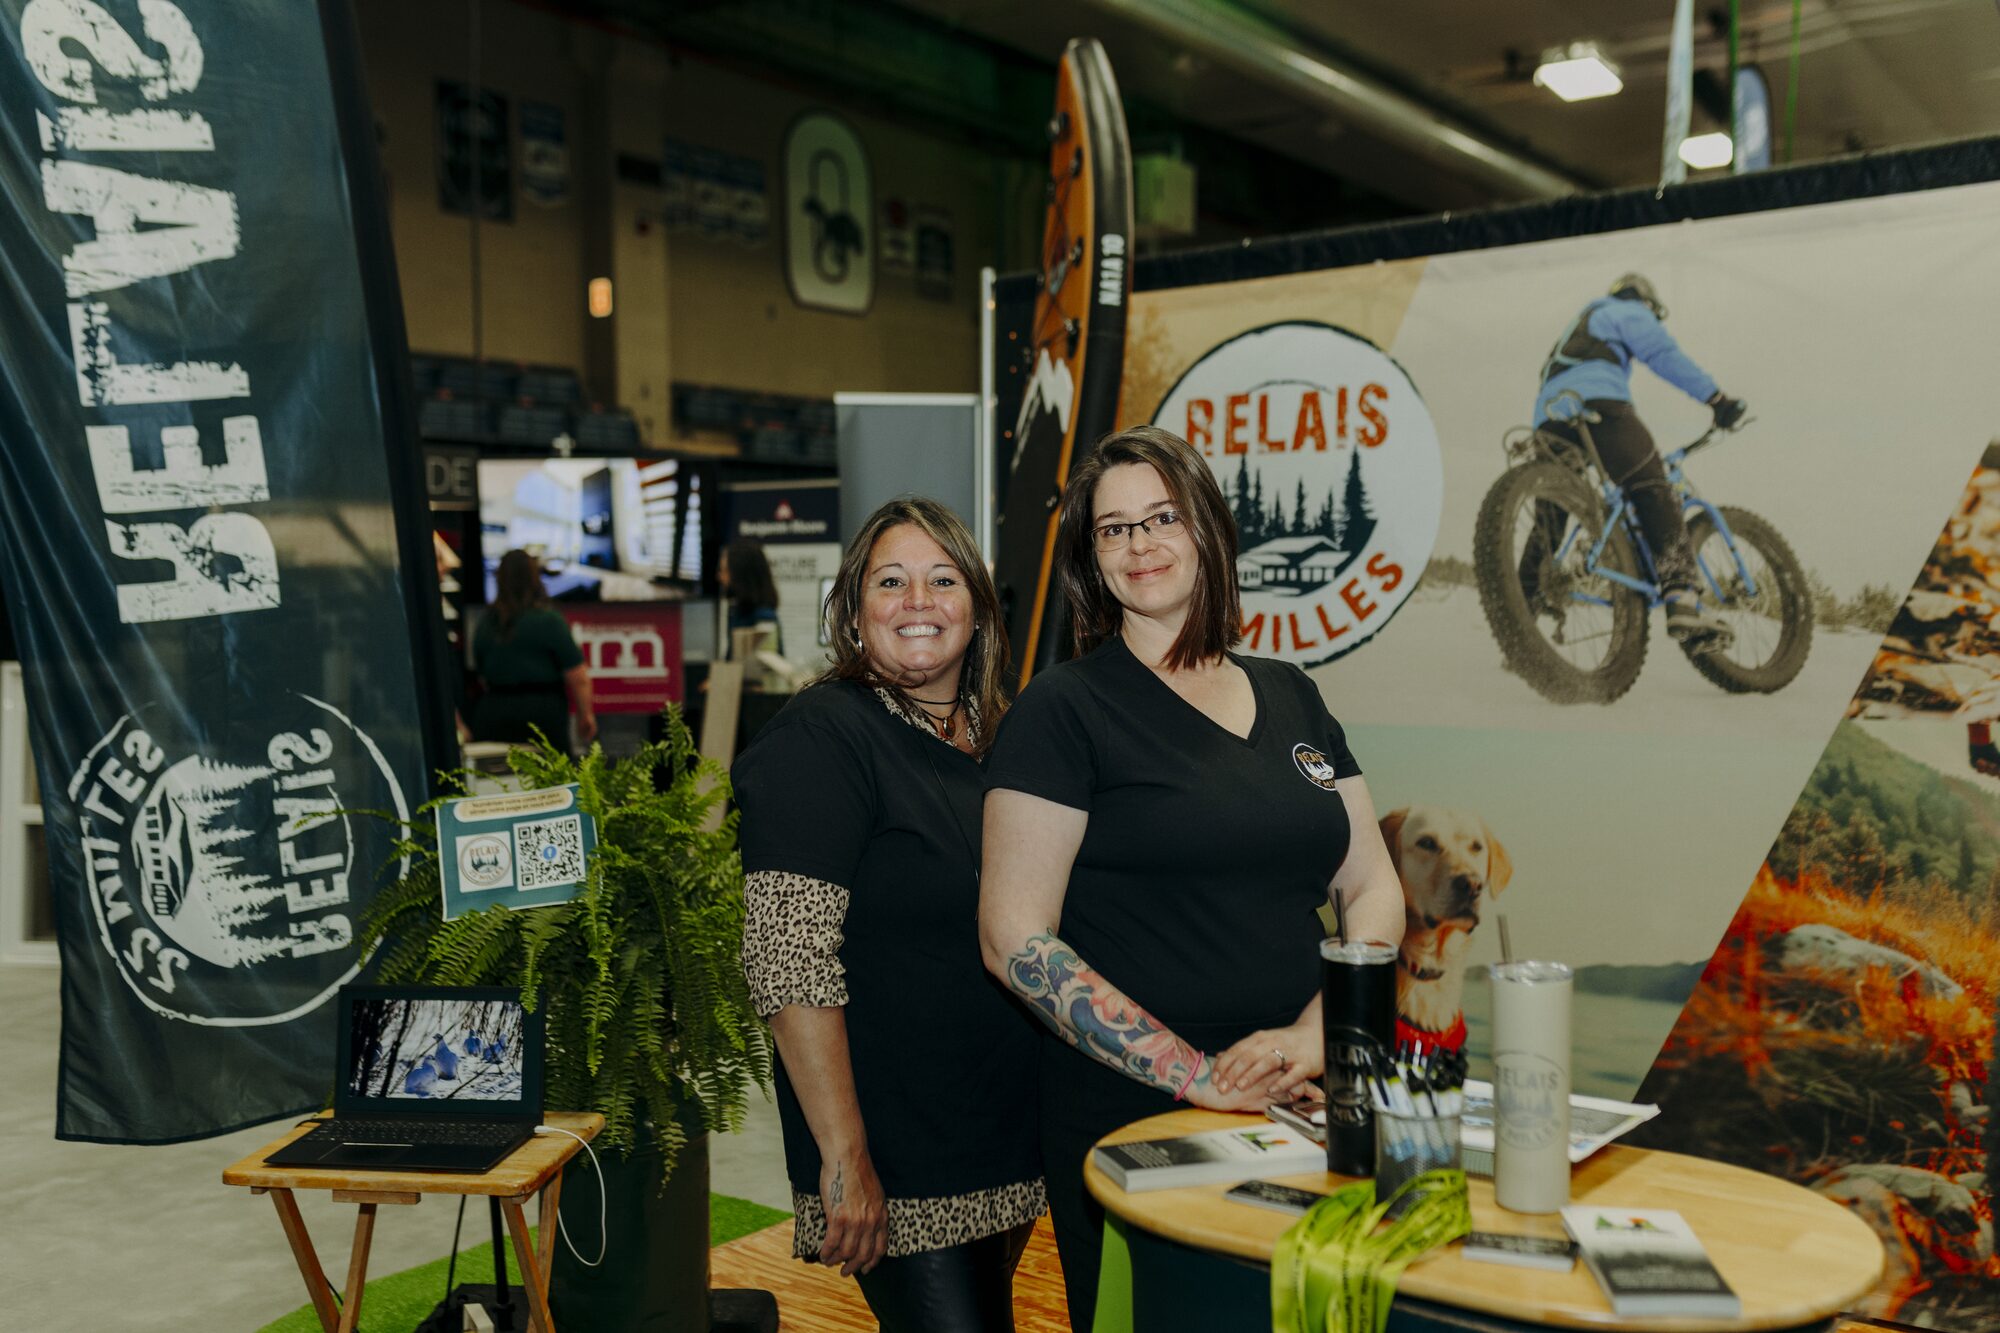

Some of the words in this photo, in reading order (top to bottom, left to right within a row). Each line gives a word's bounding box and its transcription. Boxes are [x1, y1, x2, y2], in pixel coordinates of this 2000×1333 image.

[1186, 383, 1389, 457] RELAIS
[1240, 551, 1404, 654] MILLES
[1296, 752, 1325, 763] RELAIS
